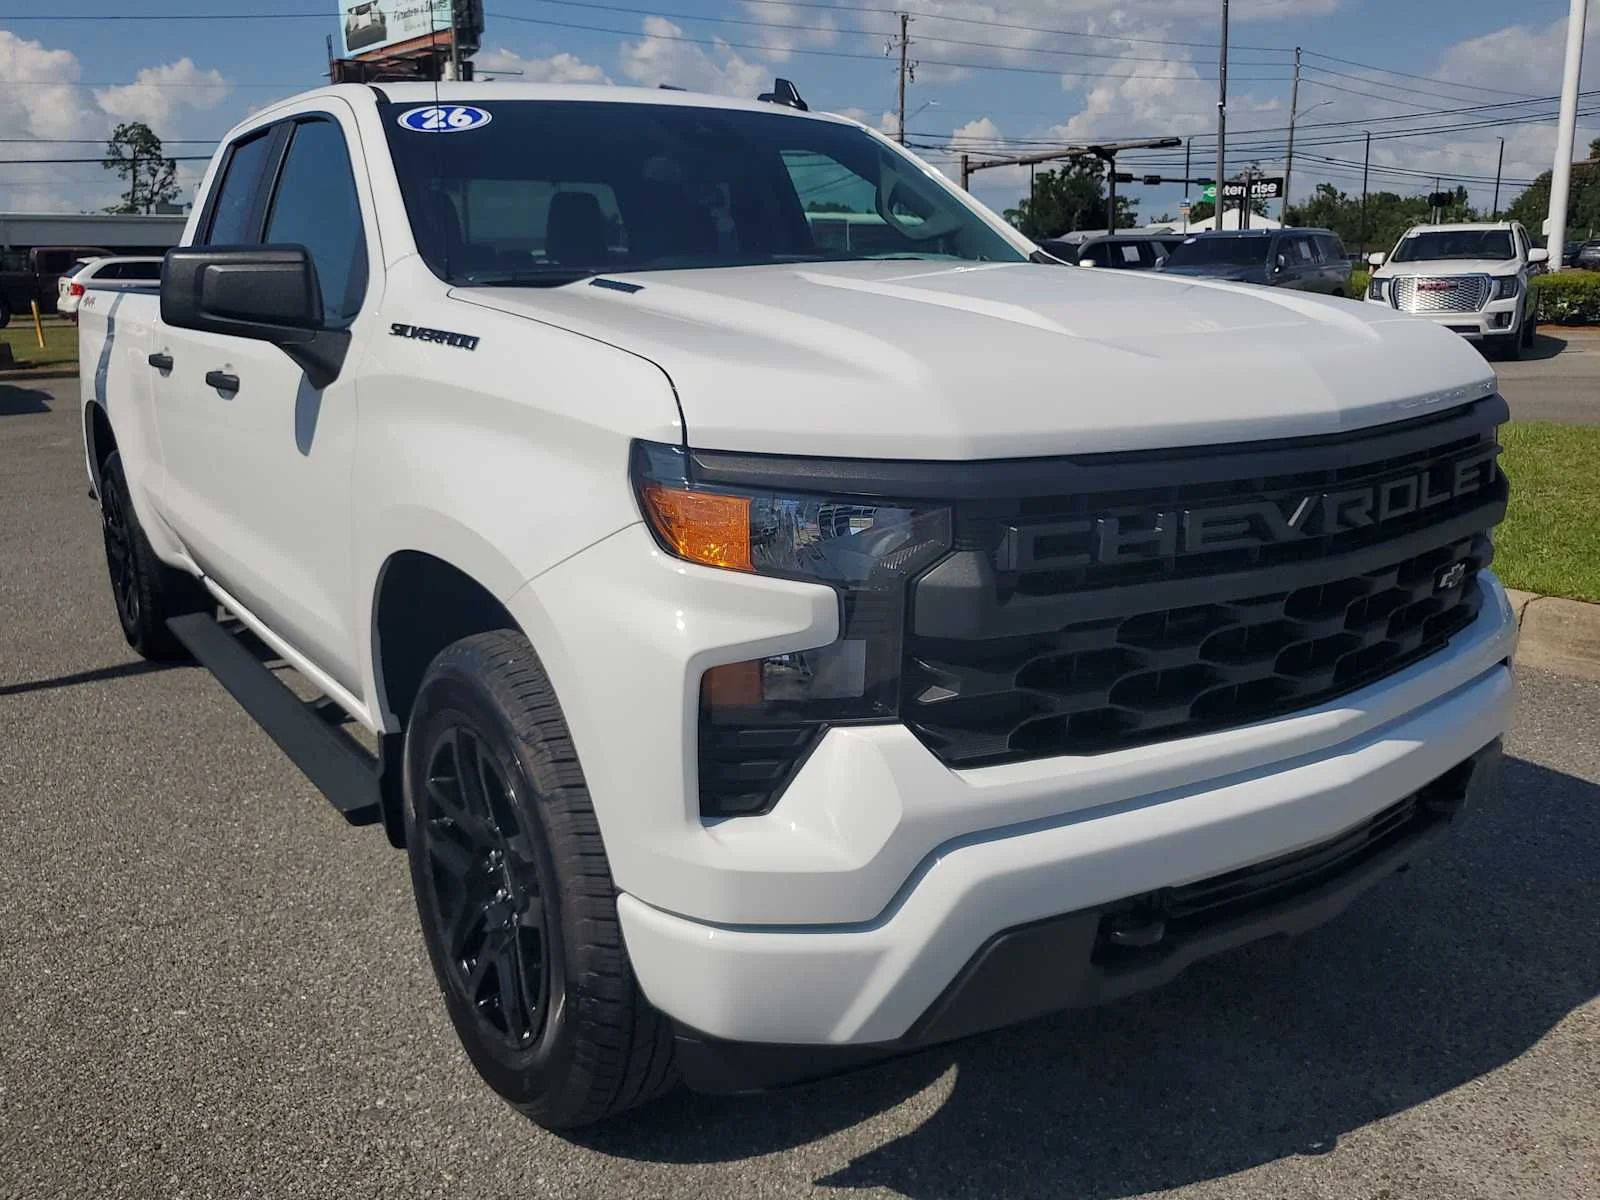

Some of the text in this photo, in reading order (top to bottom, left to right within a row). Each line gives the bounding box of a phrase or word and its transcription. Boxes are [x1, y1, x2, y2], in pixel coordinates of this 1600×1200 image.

[421, 108, 473, 129] 26
[1203, 181, 1278, 198] eterrise
[388, 322, 481, 352] SILVERADO
